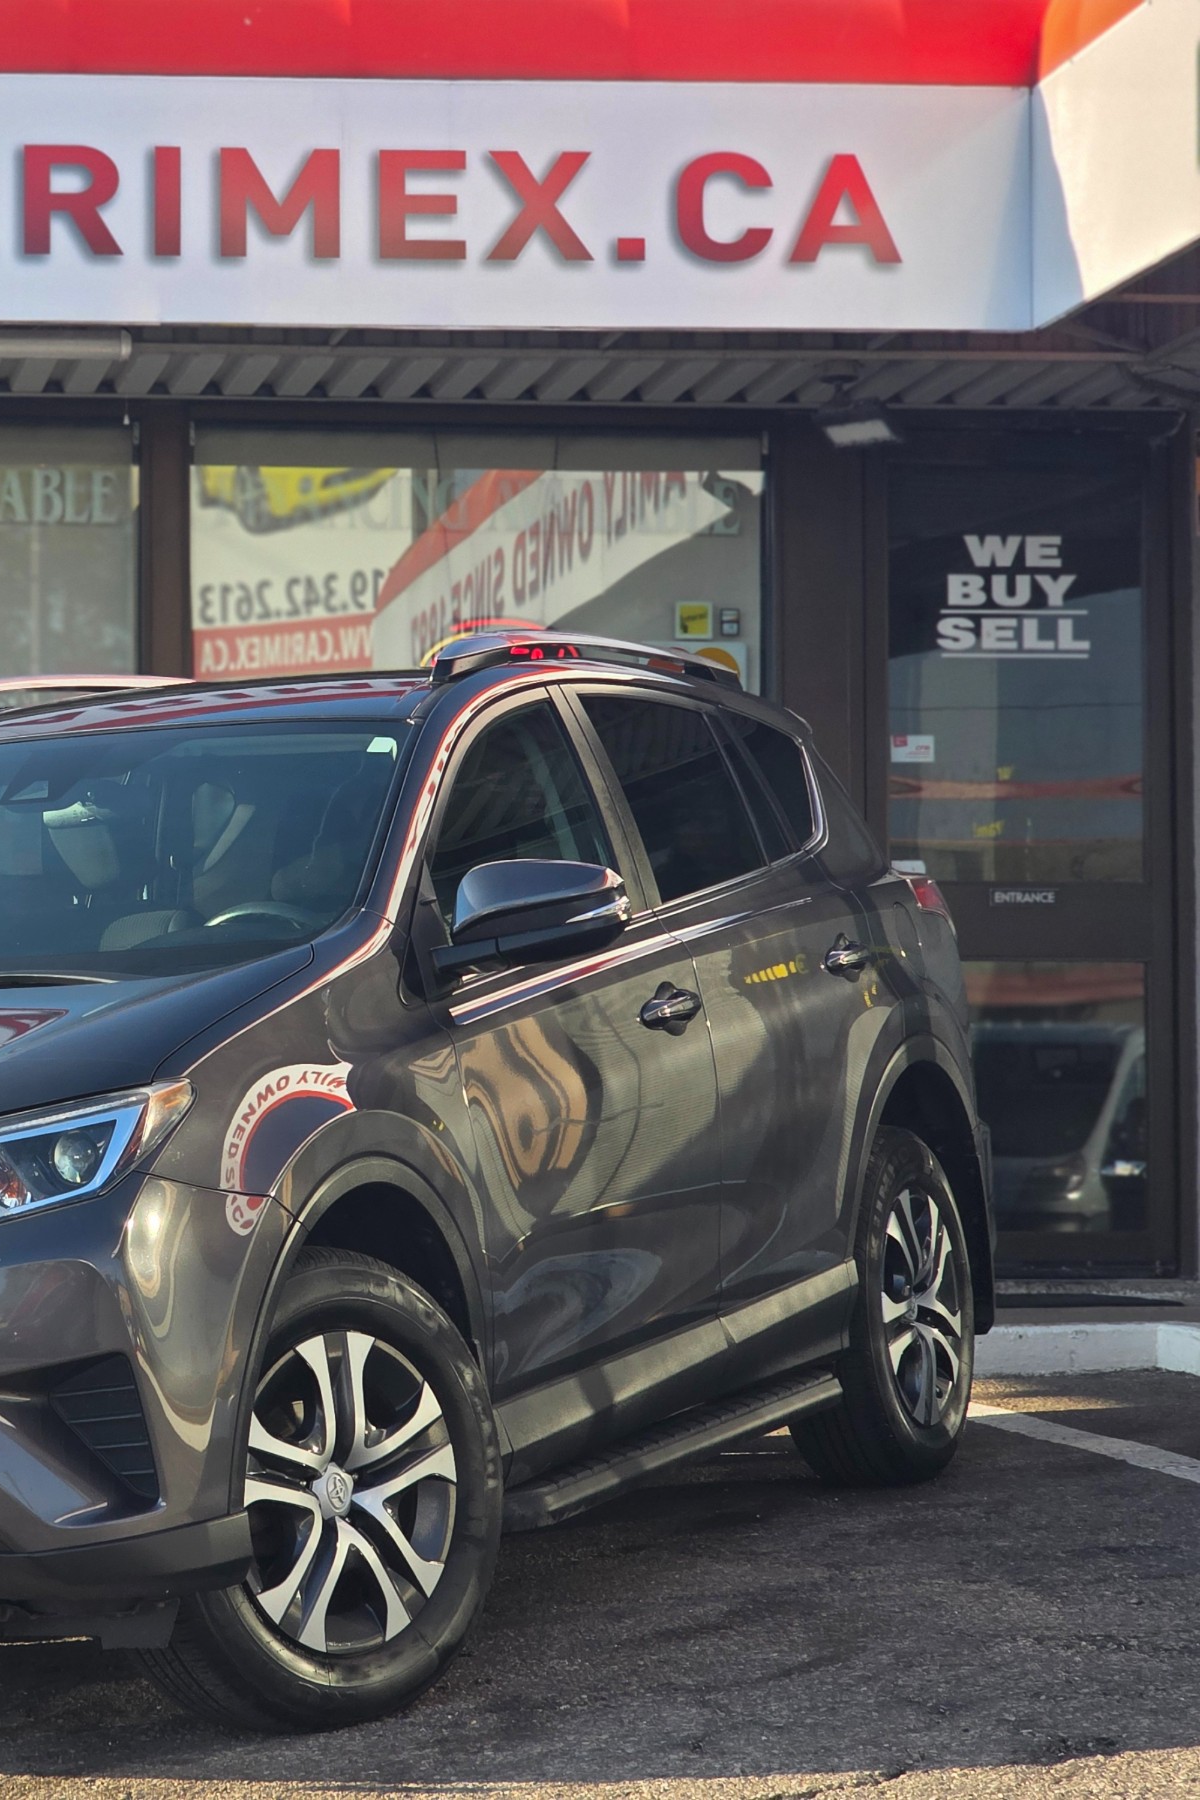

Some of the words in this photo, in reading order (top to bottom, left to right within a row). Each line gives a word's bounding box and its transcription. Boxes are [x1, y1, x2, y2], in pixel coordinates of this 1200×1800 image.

[964, 535, 1062, 568] WE
[947, 574, 1077, 607] BUY
[936, 617, 1091, 651] SELL
[994, 891, 1056, 903] ENTRANCE
